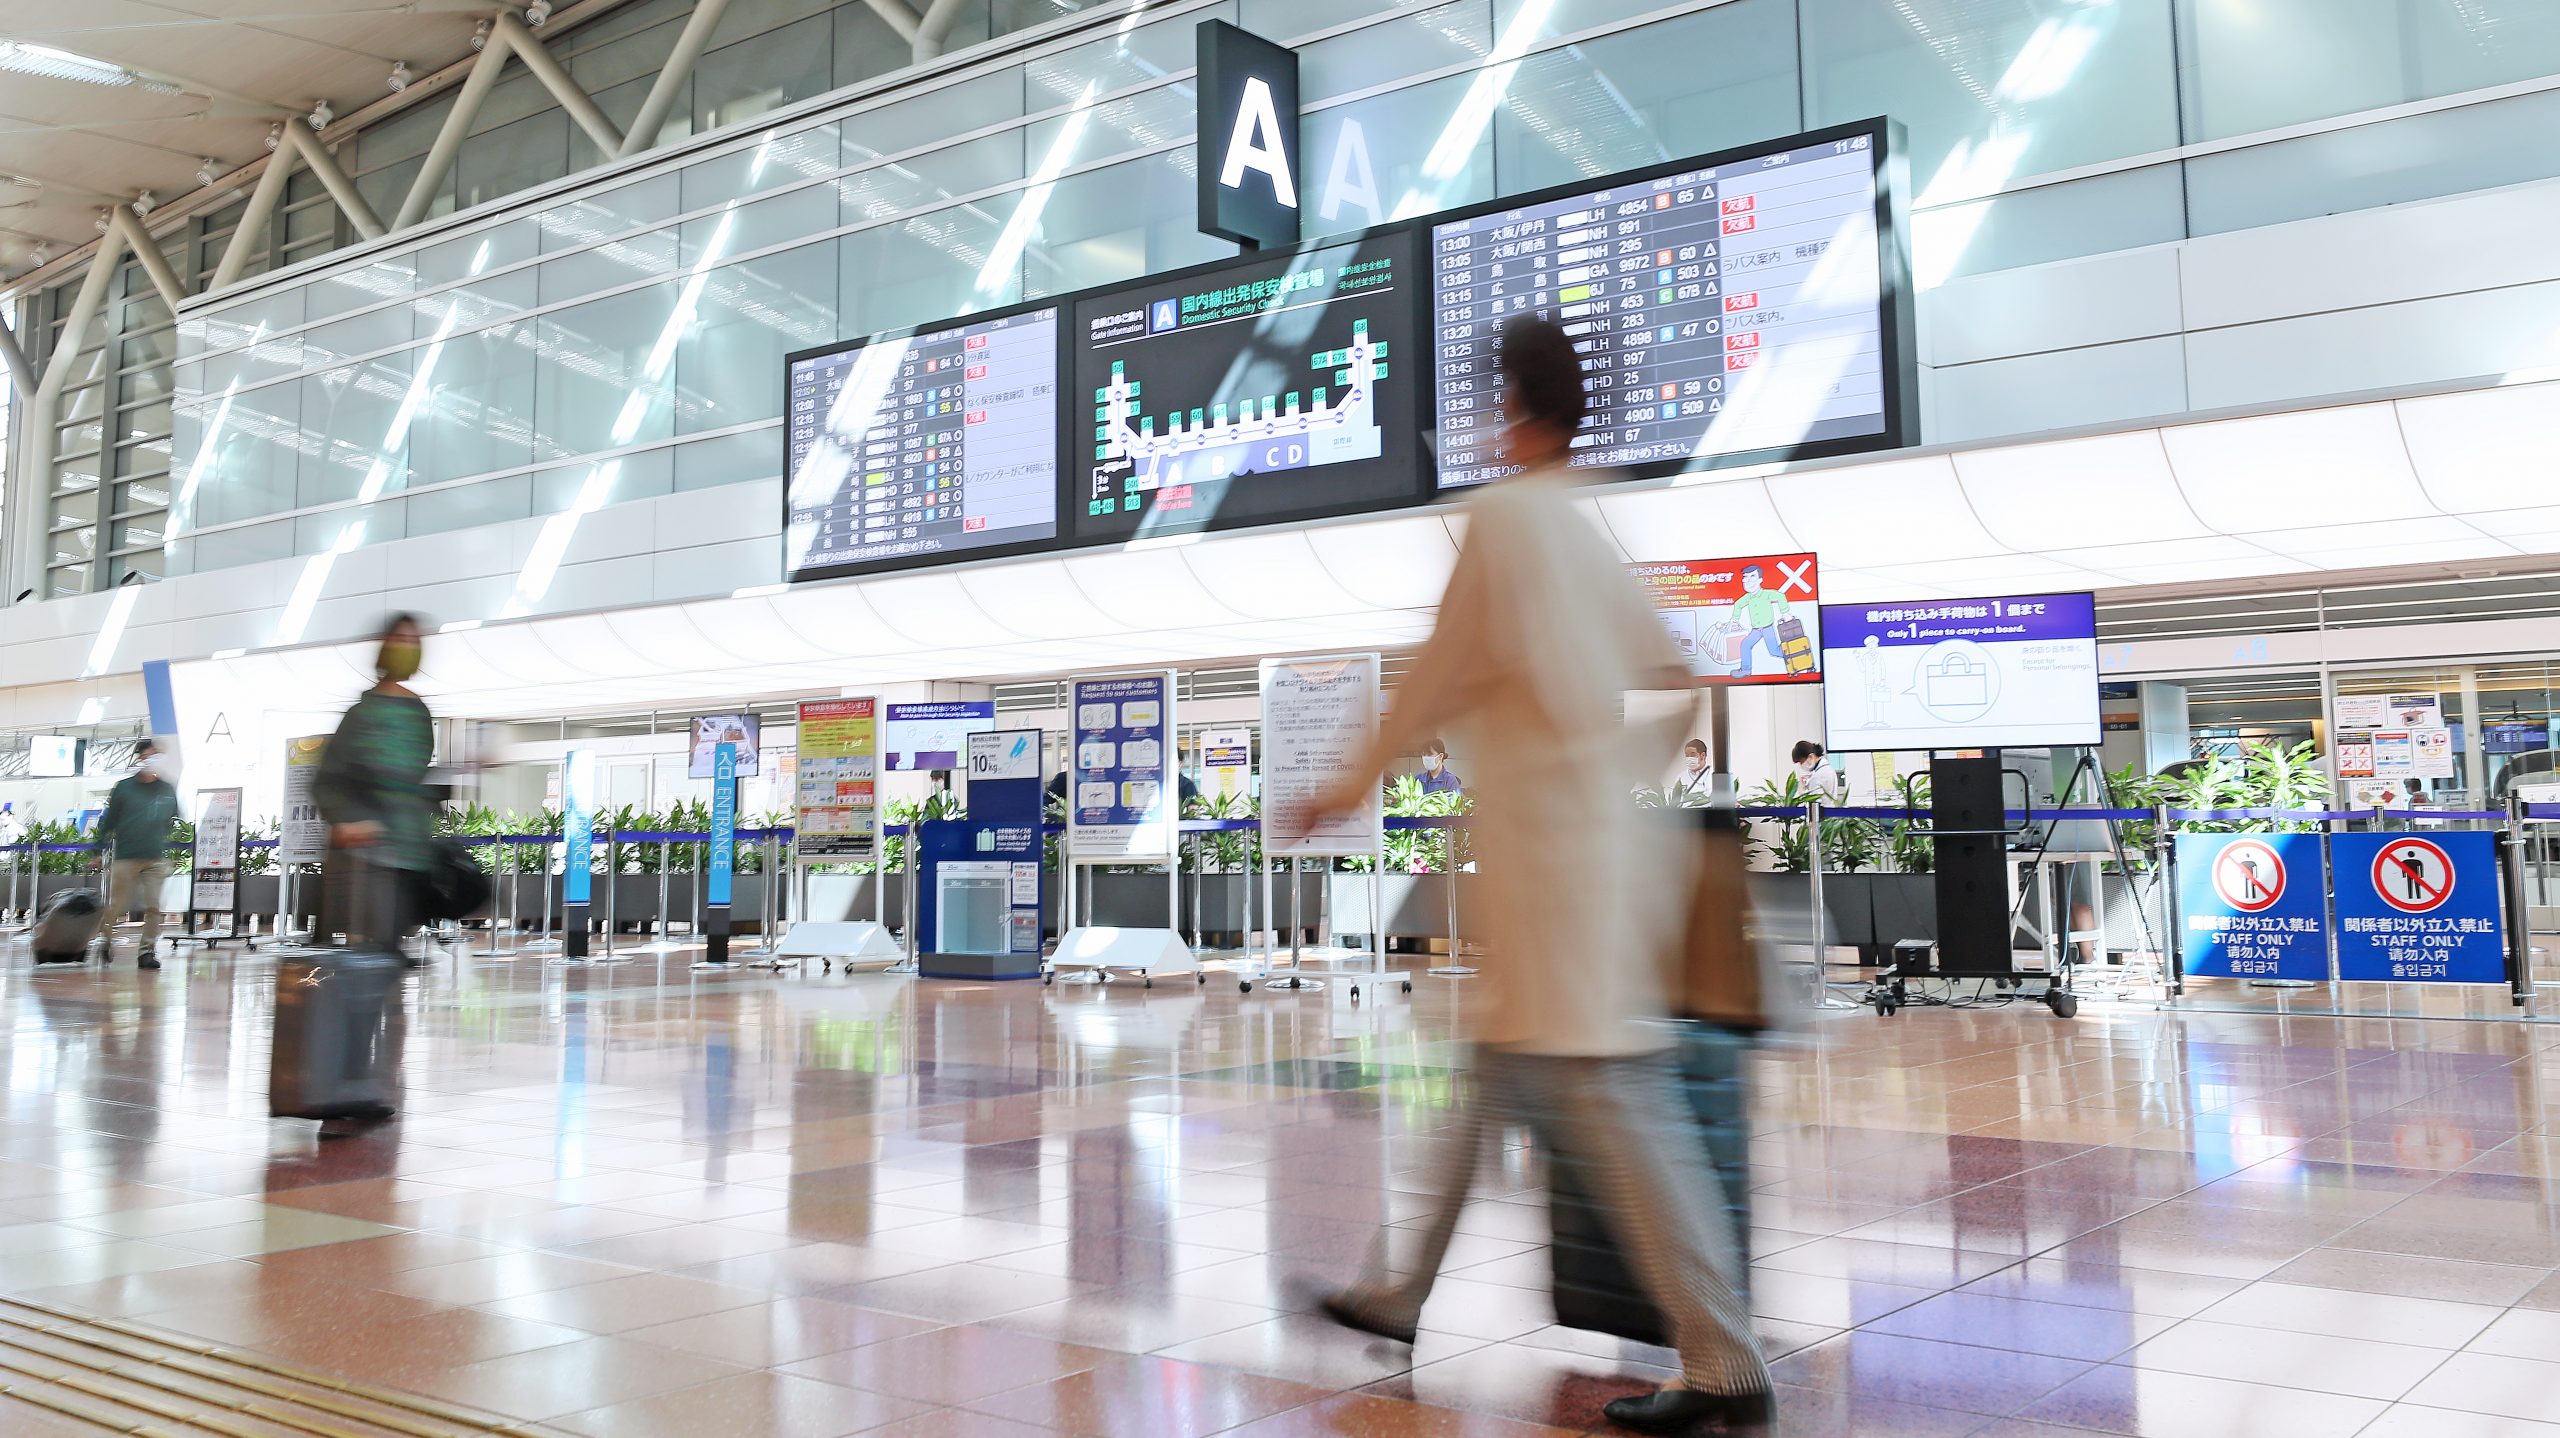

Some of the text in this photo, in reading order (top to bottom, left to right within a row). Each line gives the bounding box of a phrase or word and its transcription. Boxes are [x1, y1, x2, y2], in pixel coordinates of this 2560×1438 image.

[1219, 76, 1298, 209] A
[1440, 236, 1471, 253] 13:00
[1490, 220, 1546, 242] 大阪/伊丹
[1588, 208, 1606, 222] LH
[1676, 189, 1694, 204] 65
[1440, 253, 1472, 270] 13:05
[1490, 237, 1546, 260] 大阪/関西
[1588, 226, 1608, 242] NH
[1618, 220, 1640, 236] 991
[1441, 270, 1472, 288] 13:05
[1588, 244, 1608, 260] NH
[1618, 238, 1642, 254] 295
[1442, 288, 1472, 306] 13:15
[1590, 263, 1610, 278] GA
[1618, 255, 1650, 273] 9972
[1678, 246, 1696, 261] 60
[1181, 268, 1325, 314] 国内線出発保安検査場
[1442, 306, 1472, 323] 13:15
[1590, 282, 1605, 297] 6J
[1620, 276, 1636, 292] 75
[1676, 264, 1700, 281] 503
[1155, 303, 1174, 329] A
[1182, 308, 1220, 325] Domestic
[1221, 300, 1256, 318] Security
[1442, 324, 1472, 341] 13:20
[1591, 300, 1610, 315] NH
[1620, 294, 1644, 310] 453
[1442, 343, 1472, 358] 13:25
[1592, 318, 1611, 334] NH
[1622, 314, 1645, 329] 283
[1442, 362, 1472, 376] 13:45
[1592, 338, 1610, 351] LH
[1681, 322, 1698, 337] 47
[1443, 380, 1473, 394] 13:45
[1593, 356, 1612, 370] NH
[1623, 351, 1646, 366] 997
[1444, 397, 1474, 412] 13:50
[1594, 376, 1613, 389] HD
[1624, 371, 1640, 386] 25
[1444, 415, 1474, 431] 13:50
[1594, 394, 1611, 408] LH
[1683, 381, 1701, 395] 59
[903, 422, 918, 436] 377
[1444, 400, 1704, 448] 14:00 LH 4900 509
[1212, 455, 1225, 476] B
[1266, 446, 1280, 467] C
[1288, 444, 1303, 464] D
[1444, 452, 1474, 466] 14:00
[1594, 432, 1614, 446] NH
[1624, 428, 1640, 442] 67
[1866, 600, 2046, 624] 機内持ち込み手荷物は 1 個まで
[1886, 629, 1909, 640] Only
[1908, 622, 1918, 638] 1
[1918, 627, 1942, 638] piece
[1956, 627, 1994, 637] carry-on
[206, 712, 234, 744] A
[972, 754, 998, 774] 10 kg
[714, 752, 734, 870] 入口 ENTRANCE
[2188, 916, 2320, 934] 関係者以外立入禁止
[2212, 933, 2294, 946] STAFF ONLY
[2344, 918, 2494, 934] 関係者以外立入禁止
[2370, 935, 2465, 948] STAFF ONLY
[2226, 946, 2280, 960] 请勿入内
[2230, 960, 2278, 975] 출입금지
[2388, 948, 2449, 963] 请勿入内
[2392, 964, 2446, 978] 출입금지
